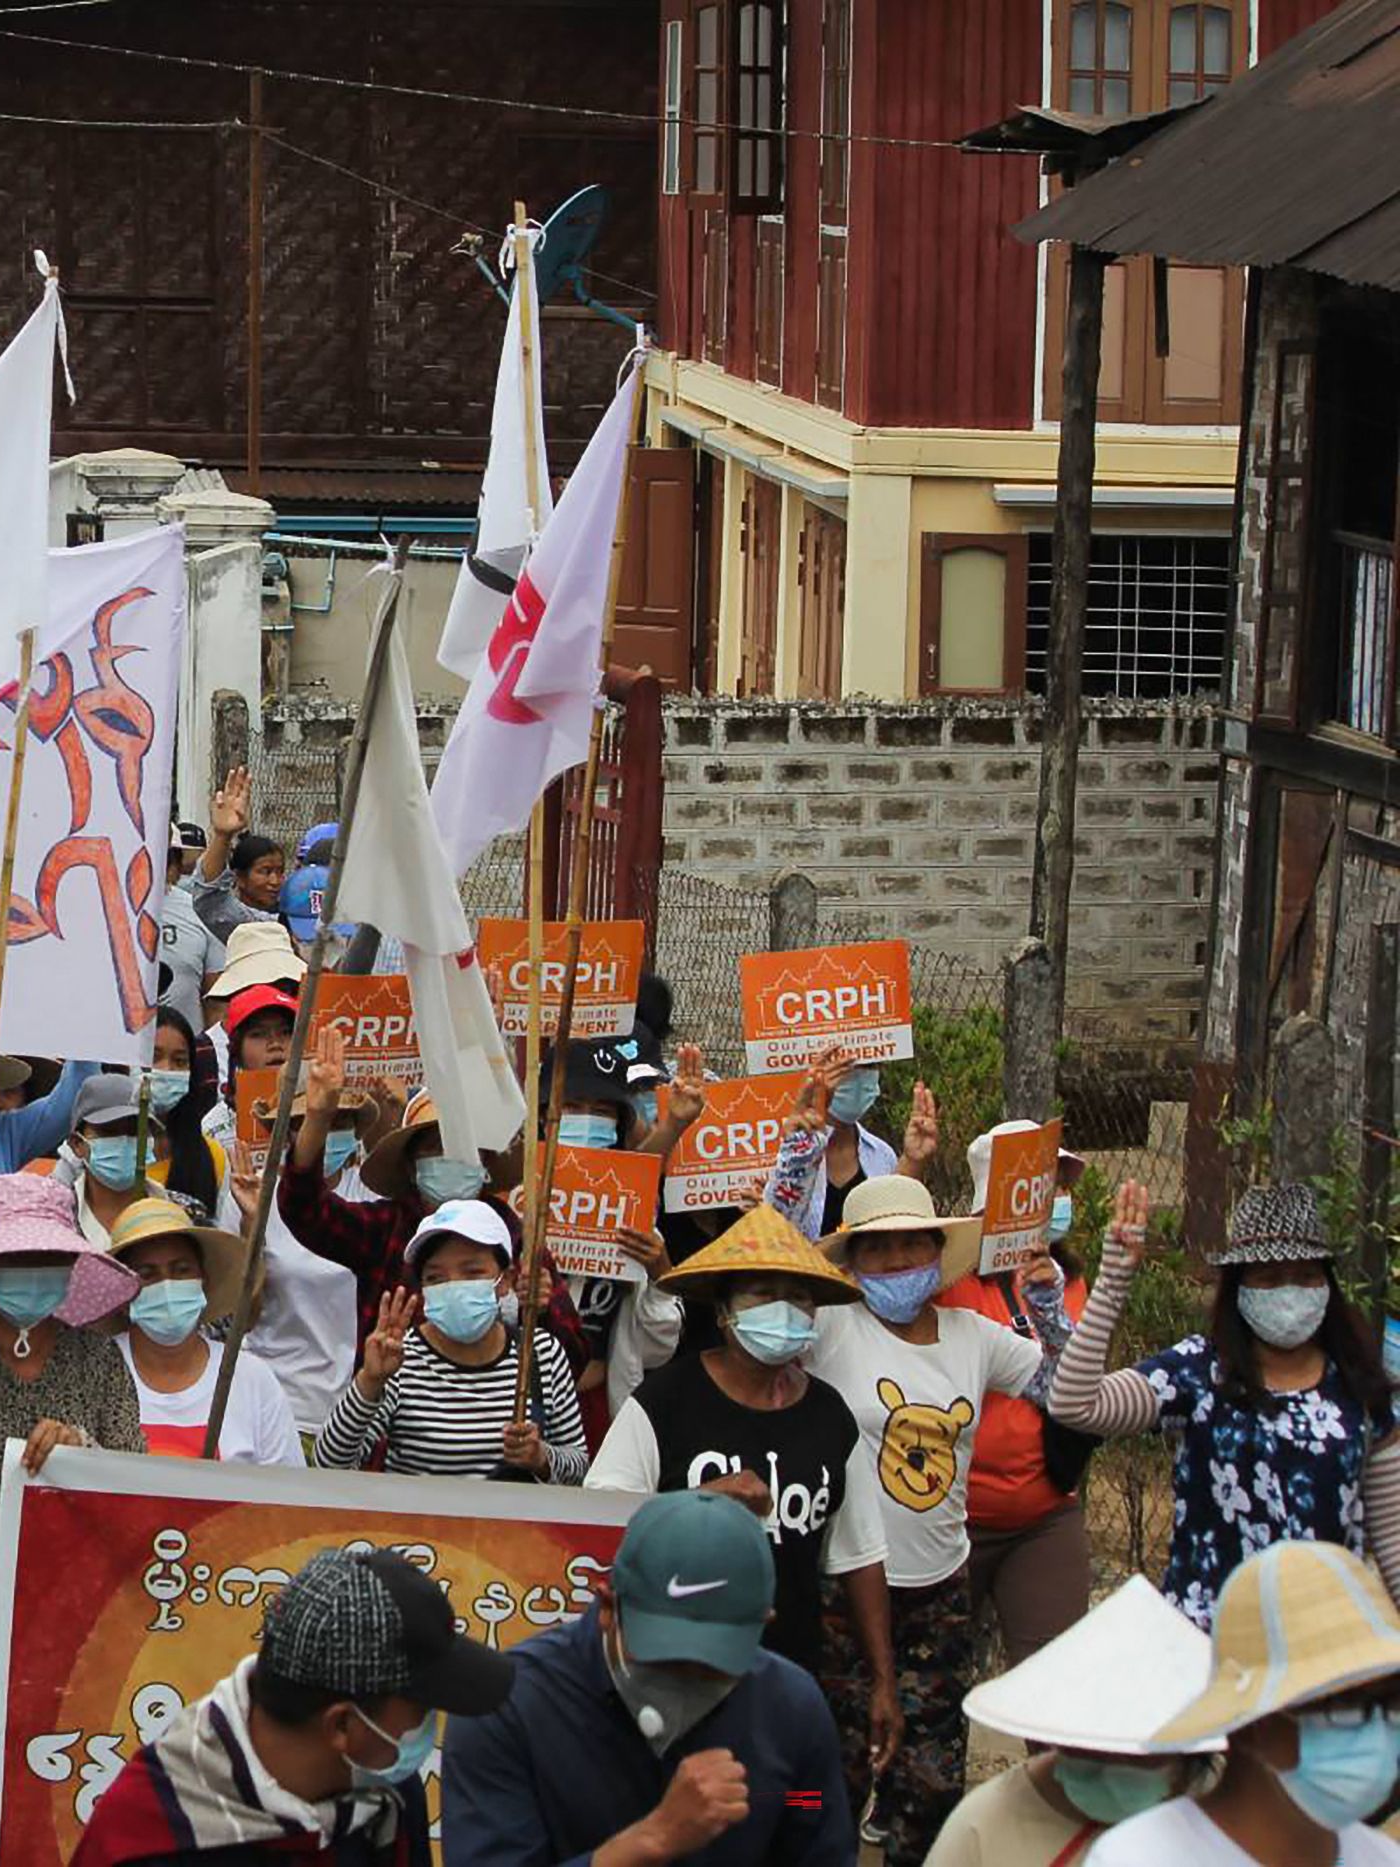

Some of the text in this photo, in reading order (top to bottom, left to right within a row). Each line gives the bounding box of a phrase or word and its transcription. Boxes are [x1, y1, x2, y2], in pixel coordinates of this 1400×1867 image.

[776, 983, 886, 1025] CRPH
[767, 1041, 798, 1053] Our
[696, 1119, 784, 1160] CRP
[686, 1178, 717, 1189] Our
[549, 1188, 628, 1232] RPH
